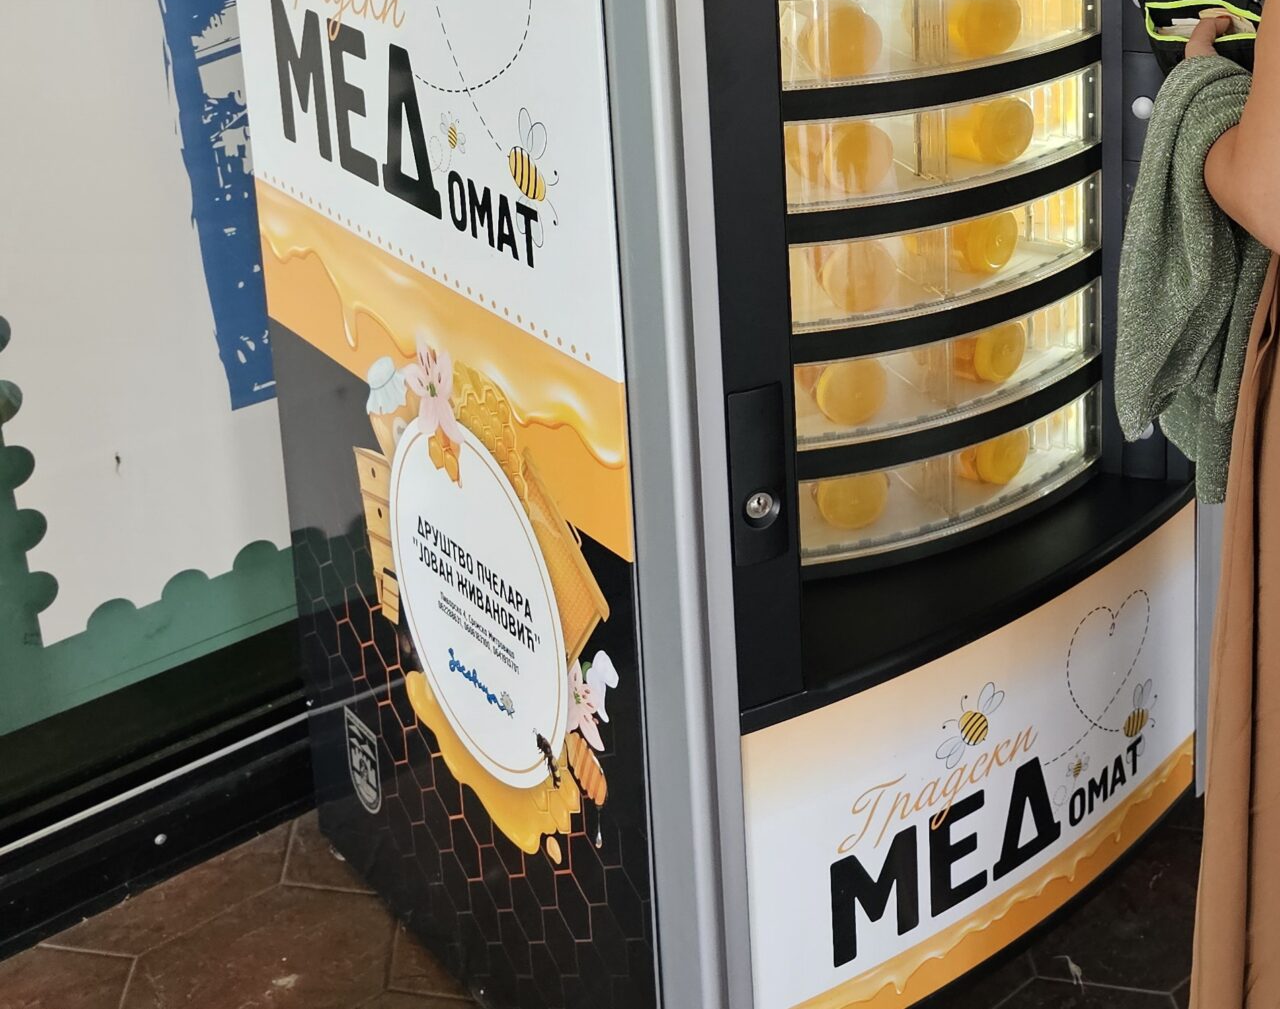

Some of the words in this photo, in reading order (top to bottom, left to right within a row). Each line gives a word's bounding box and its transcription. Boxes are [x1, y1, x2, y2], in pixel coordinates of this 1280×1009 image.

[412, 536, 454, 587] "ЈОВАН
[417, 515, 474, 575] ДРУШТВО
[477, 559, 533, 622] ПЧЕЛАРА
